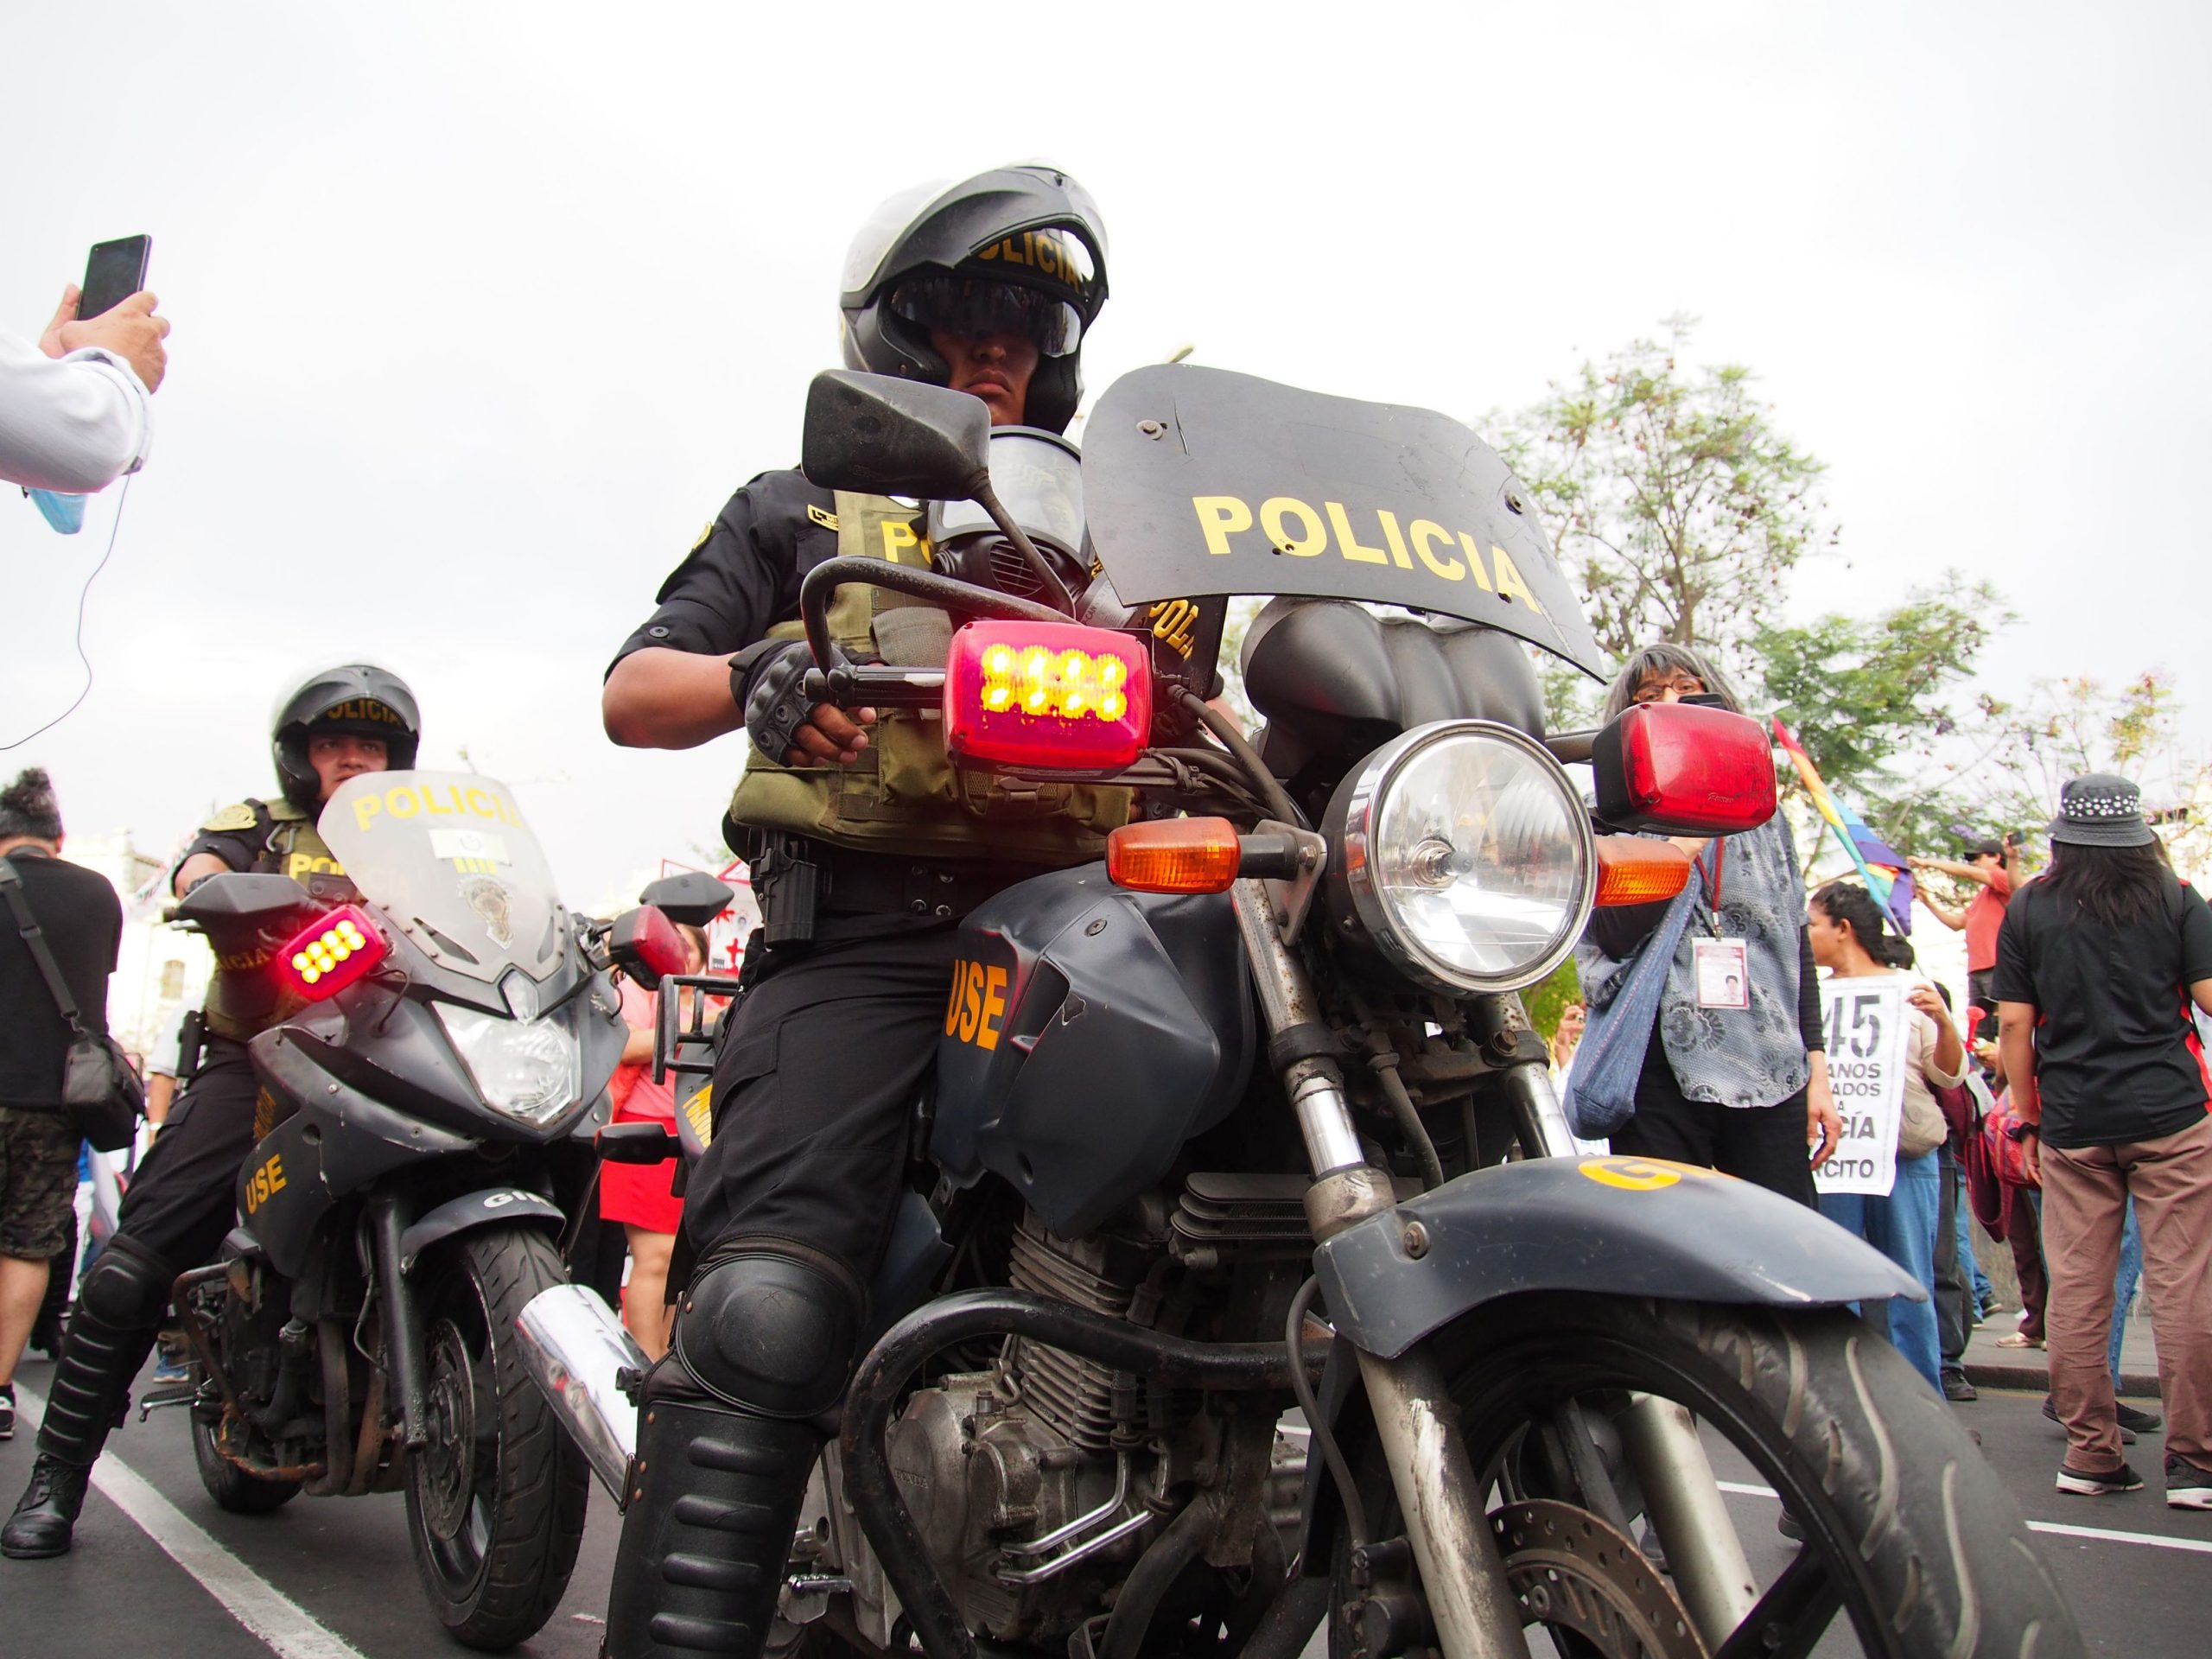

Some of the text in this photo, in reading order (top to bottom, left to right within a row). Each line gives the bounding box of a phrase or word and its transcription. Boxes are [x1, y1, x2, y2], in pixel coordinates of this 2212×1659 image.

[881, 520, 931, 563] P
[1192, 496, 1541, 614] POLICIA
[946, 959, 1007, 1051] USE
[1822, 995, 1881, 1058] 45
[245, 1154, 288, 1215] USE
